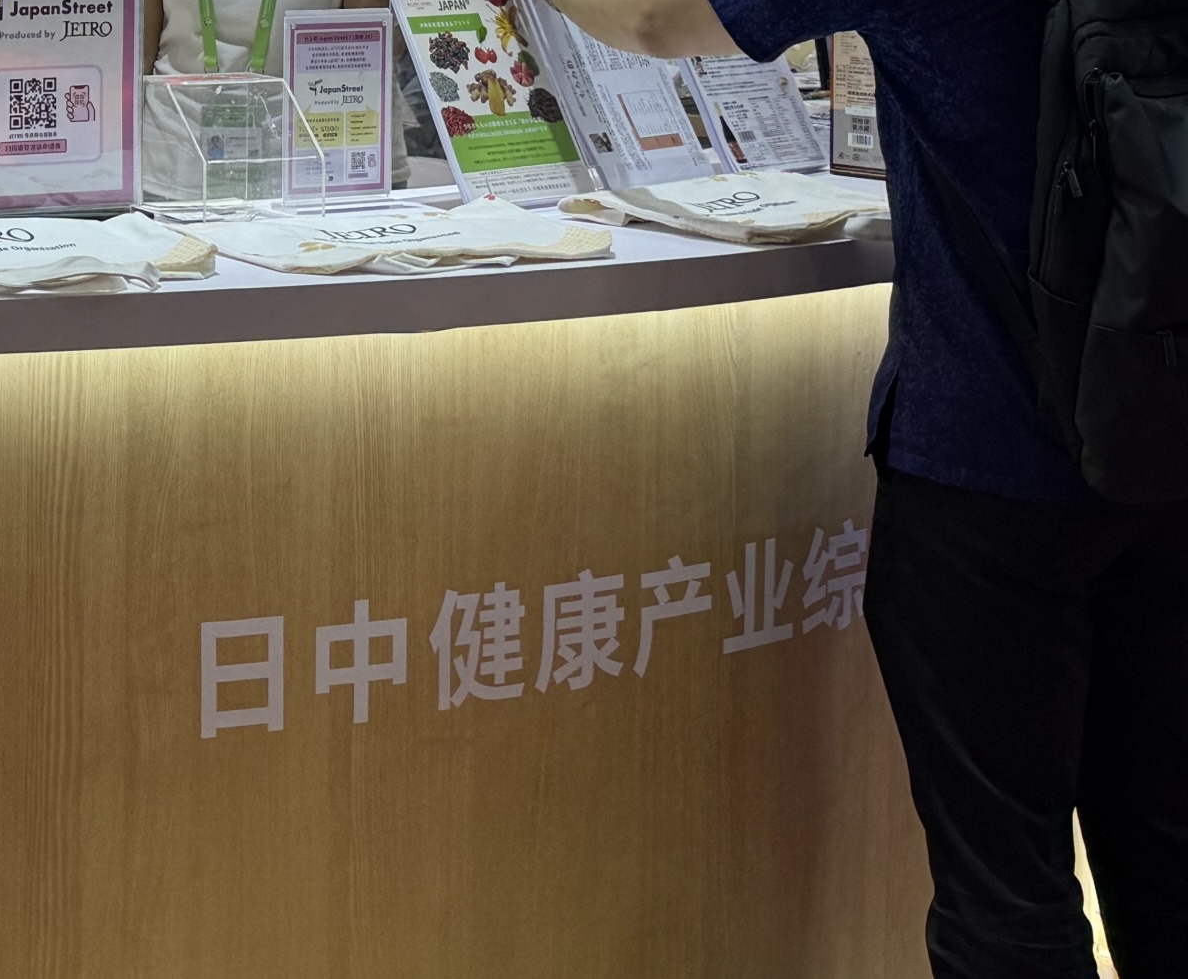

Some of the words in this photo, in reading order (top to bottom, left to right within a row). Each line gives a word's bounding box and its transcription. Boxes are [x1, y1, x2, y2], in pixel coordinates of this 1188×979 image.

[44, 29, 56, 41] by
[59, 20, 113, 42] JETRO
[340, 94, 364, 106] JETRO
[200, 518, 868, 739] 日中健康产业综
